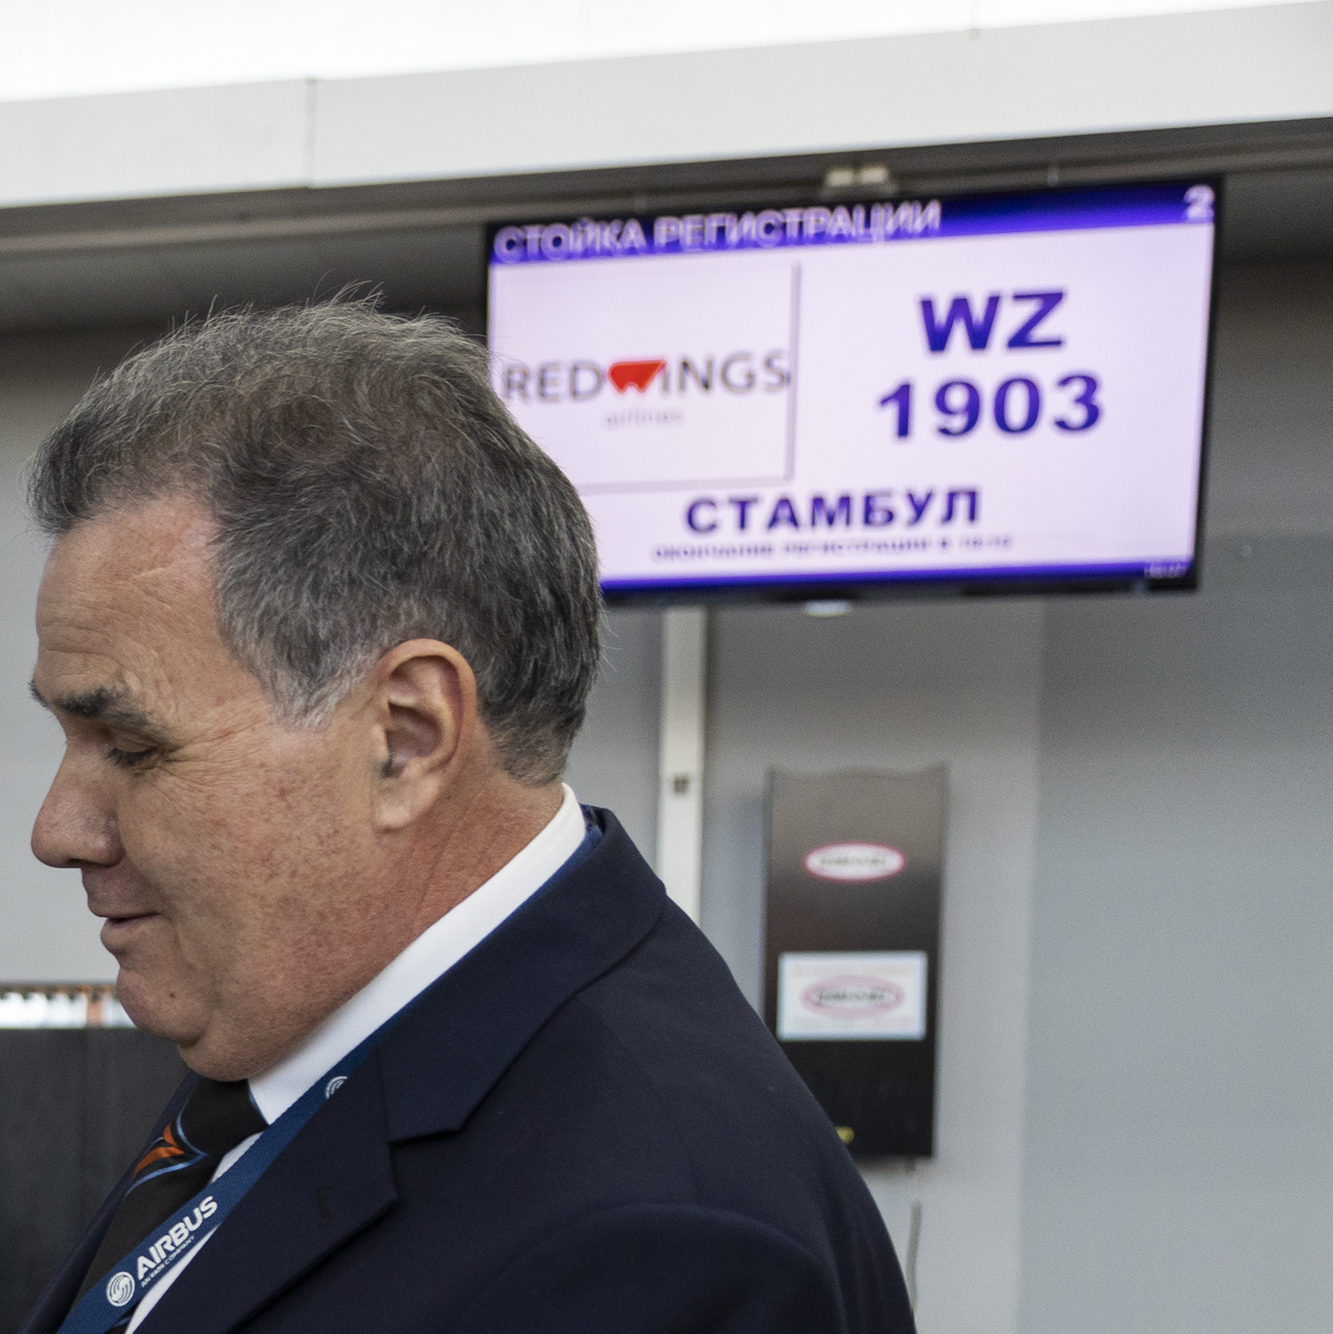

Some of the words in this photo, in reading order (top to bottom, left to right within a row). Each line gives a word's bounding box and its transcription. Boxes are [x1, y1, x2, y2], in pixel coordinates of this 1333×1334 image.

[493, 217, 647, 263] СТОЙКА
[653, 200, 942, 253] РЕГИСТРАЦИИ
[919, 289, 1067, 354] WZ
[878, 372, 1104, 440] 1903
[684, 488, 981, 534] СТАМБУЛ
[137, 1196, 218, 1280] AIRBUS
